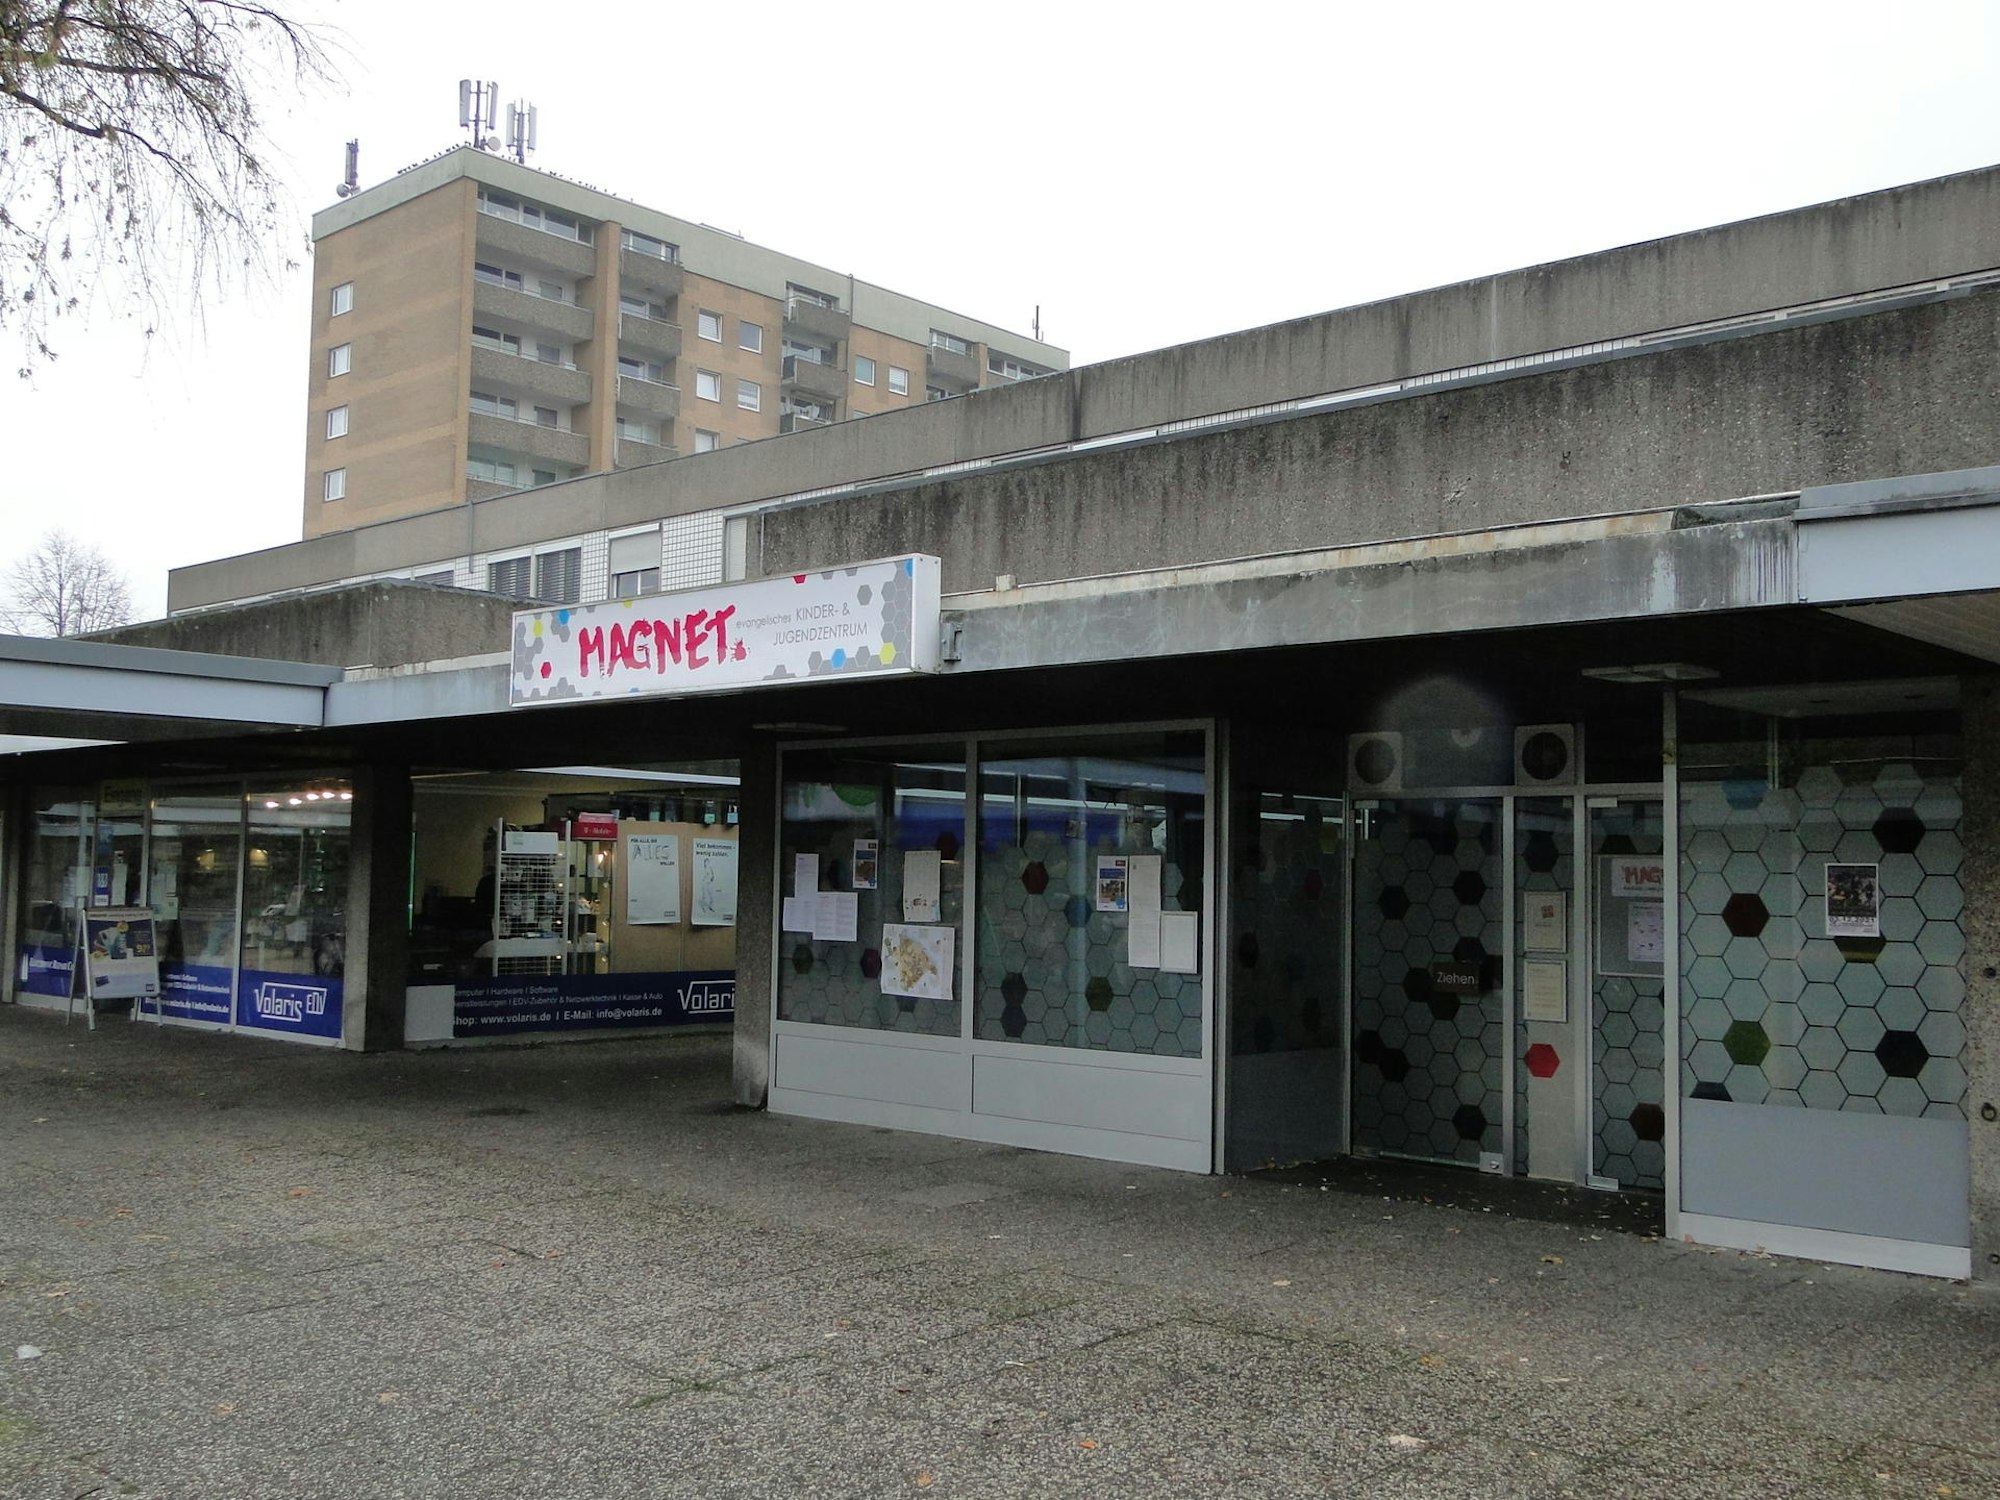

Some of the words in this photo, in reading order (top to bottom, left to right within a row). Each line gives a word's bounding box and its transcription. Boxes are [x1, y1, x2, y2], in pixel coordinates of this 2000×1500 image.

[736, 613, 792, 629] evangelisches
[796, 603, 839, 621] KINDER-
[842, 602, 850, 616] &
[579, 605, 735, 678] MAGNET
[773, 622, 867, 646] JUGENDZENTRUM
[1625, 866, 1664, 885] MAG
[254, 982, 302, 1022] Volaris
[677, 980, 735, 1014] Volari
[454, 1015, 478, 1026] hop:
[480, 1012, 552, 1024] www.volaris.de
[564, 1009, 594, 1020] E-Mail:
[596, 1007, 663, 1020] info@volaris.de
